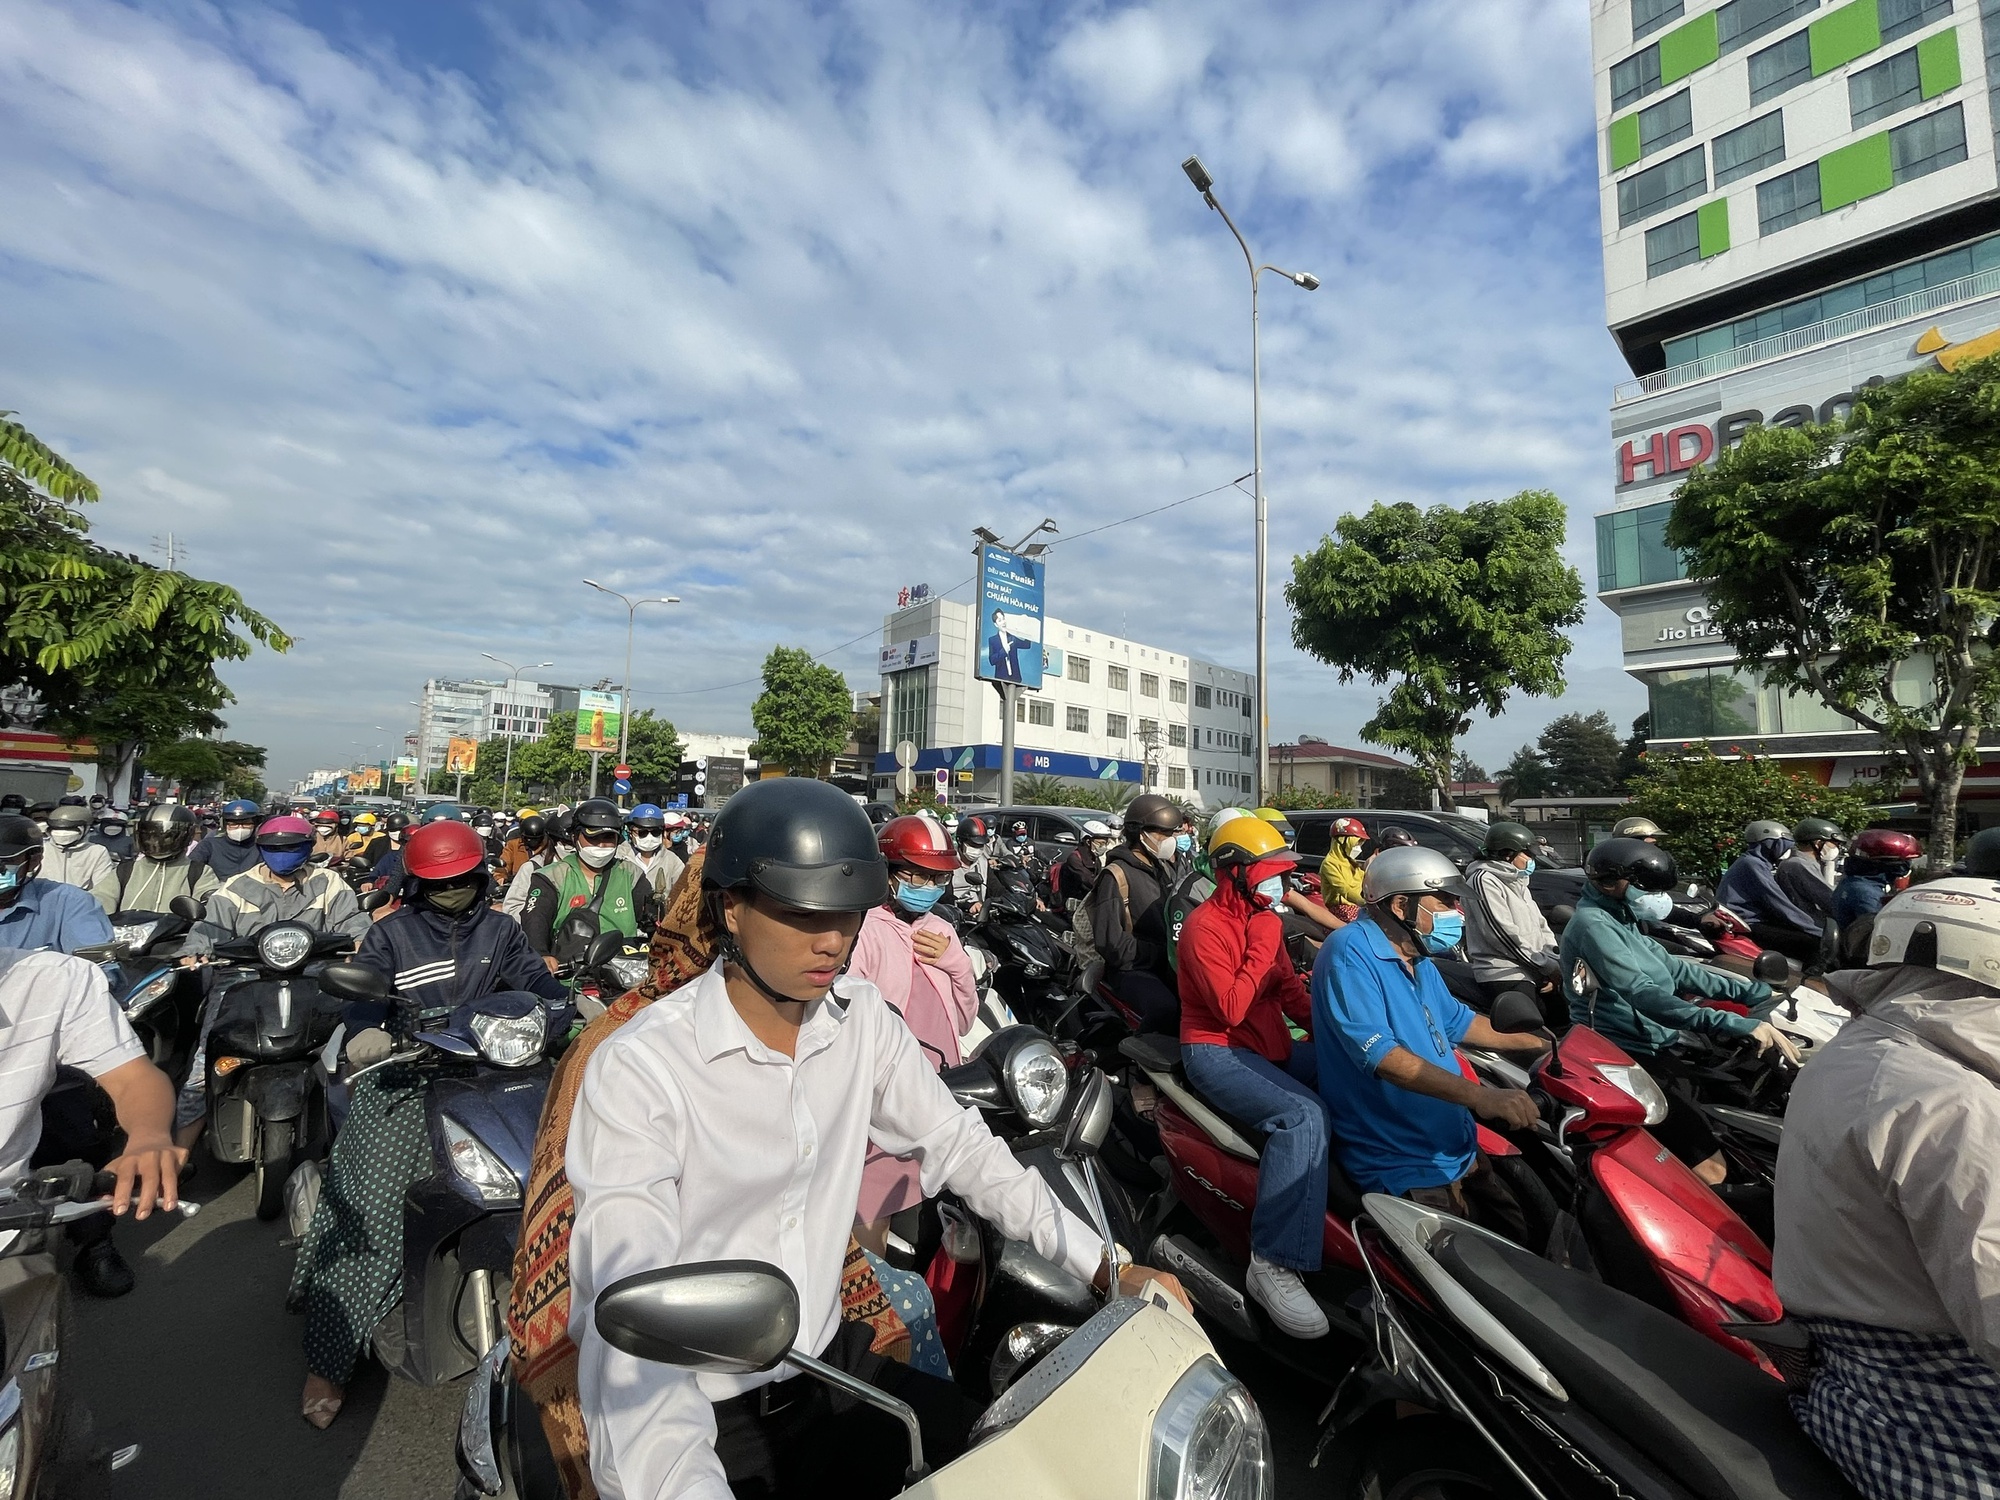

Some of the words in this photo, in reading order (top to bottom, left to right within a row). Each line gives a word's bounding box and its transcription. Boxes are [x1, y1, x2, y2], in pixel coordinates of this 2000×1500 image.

[1621, 375, 1886, 483] HDBan
[1010, 571, 1035, 587] Funiki
[1024, 603, 1039, 613] PHÁT
[1657, 627, 1687, 641] Jio
[1034, 756, 1050, 768] MB
[1853, 767, 1880, 778] HD
[504, 1083, 533, 1092] HONDA
